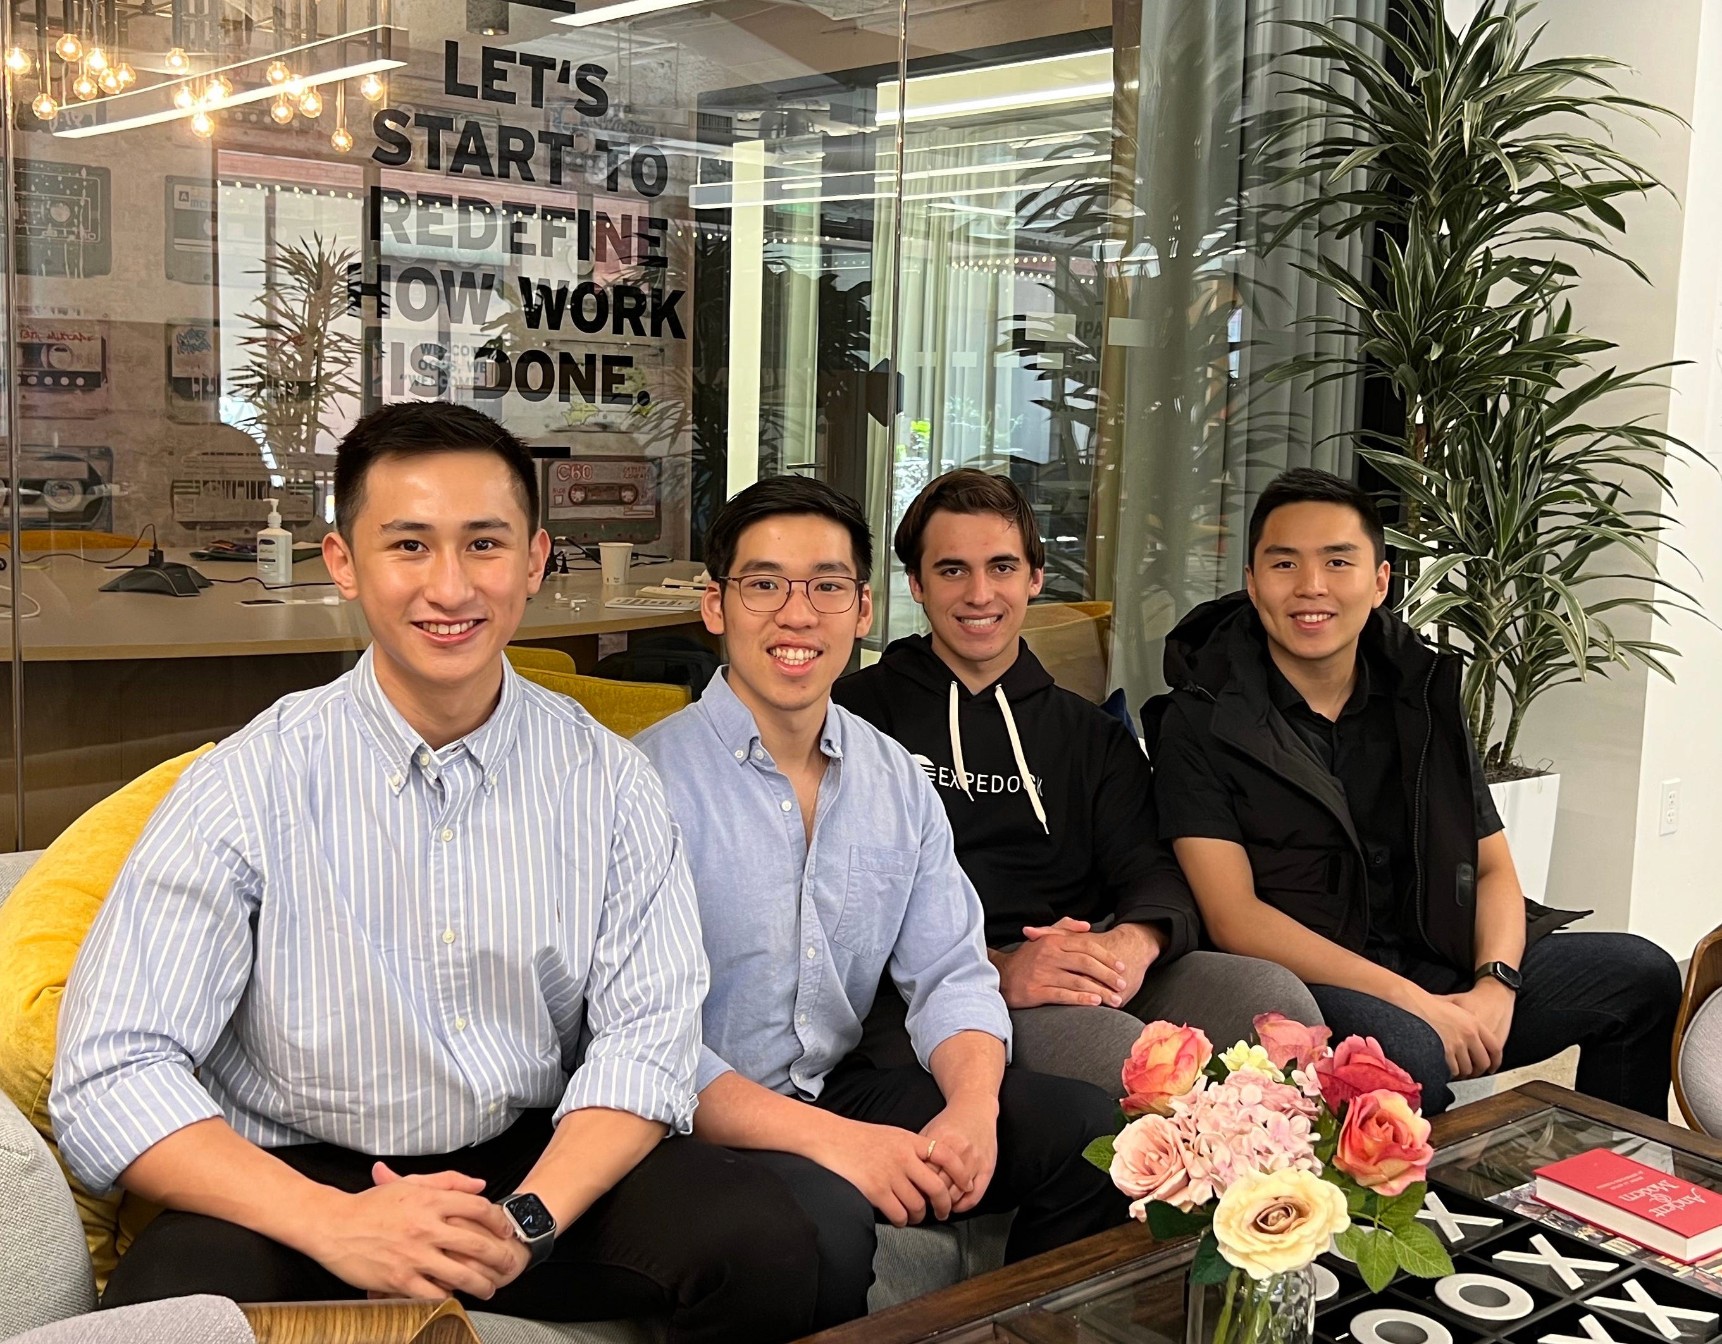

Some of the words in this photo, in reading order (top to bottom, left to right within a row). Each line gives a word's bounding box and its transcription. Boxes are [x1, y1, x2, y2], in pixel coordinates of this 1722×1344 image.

[445, 39, 609, 118] LET'S
[371, 108, 574, 186] START
[595, 139, 669, 197] TO
[370, 185, 669, 269] REDEFINE
[347, 261, 495, 325] HOW
[518, 275, 686, 340] WORK
[390, 342, 448, 398] IS
[473, 346, 651, 407] DONE.
[557, 463, 593, 482] C60
[1618, 1179, 1680, 1202] Modern
[1648, 1187, 1706, 1218] Ancient
